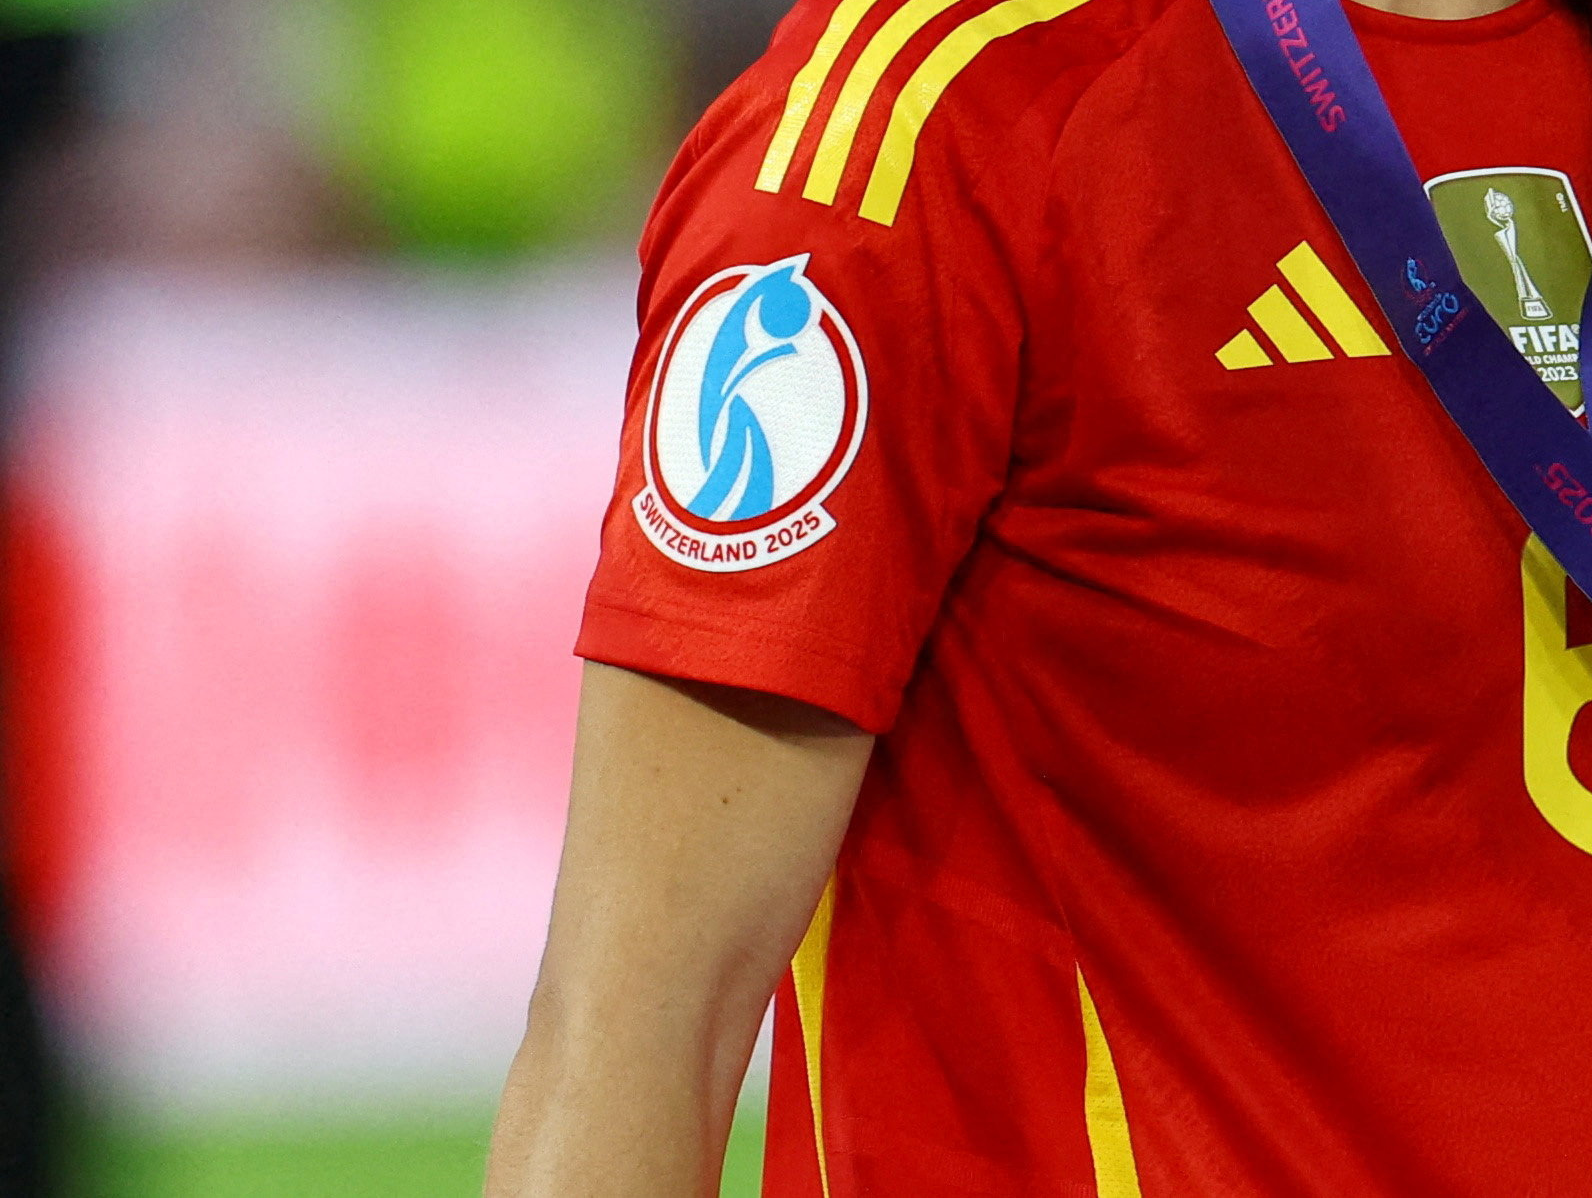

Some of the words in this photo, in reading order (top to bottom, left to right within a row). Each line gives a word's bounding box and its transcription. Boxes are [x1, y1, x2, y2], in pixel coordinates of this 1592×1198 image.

[1537, 365, 1579, 382] 2023
[640, 492, 757, 563] SWITZERLAND
[765, 510, 821, 554] 2025
